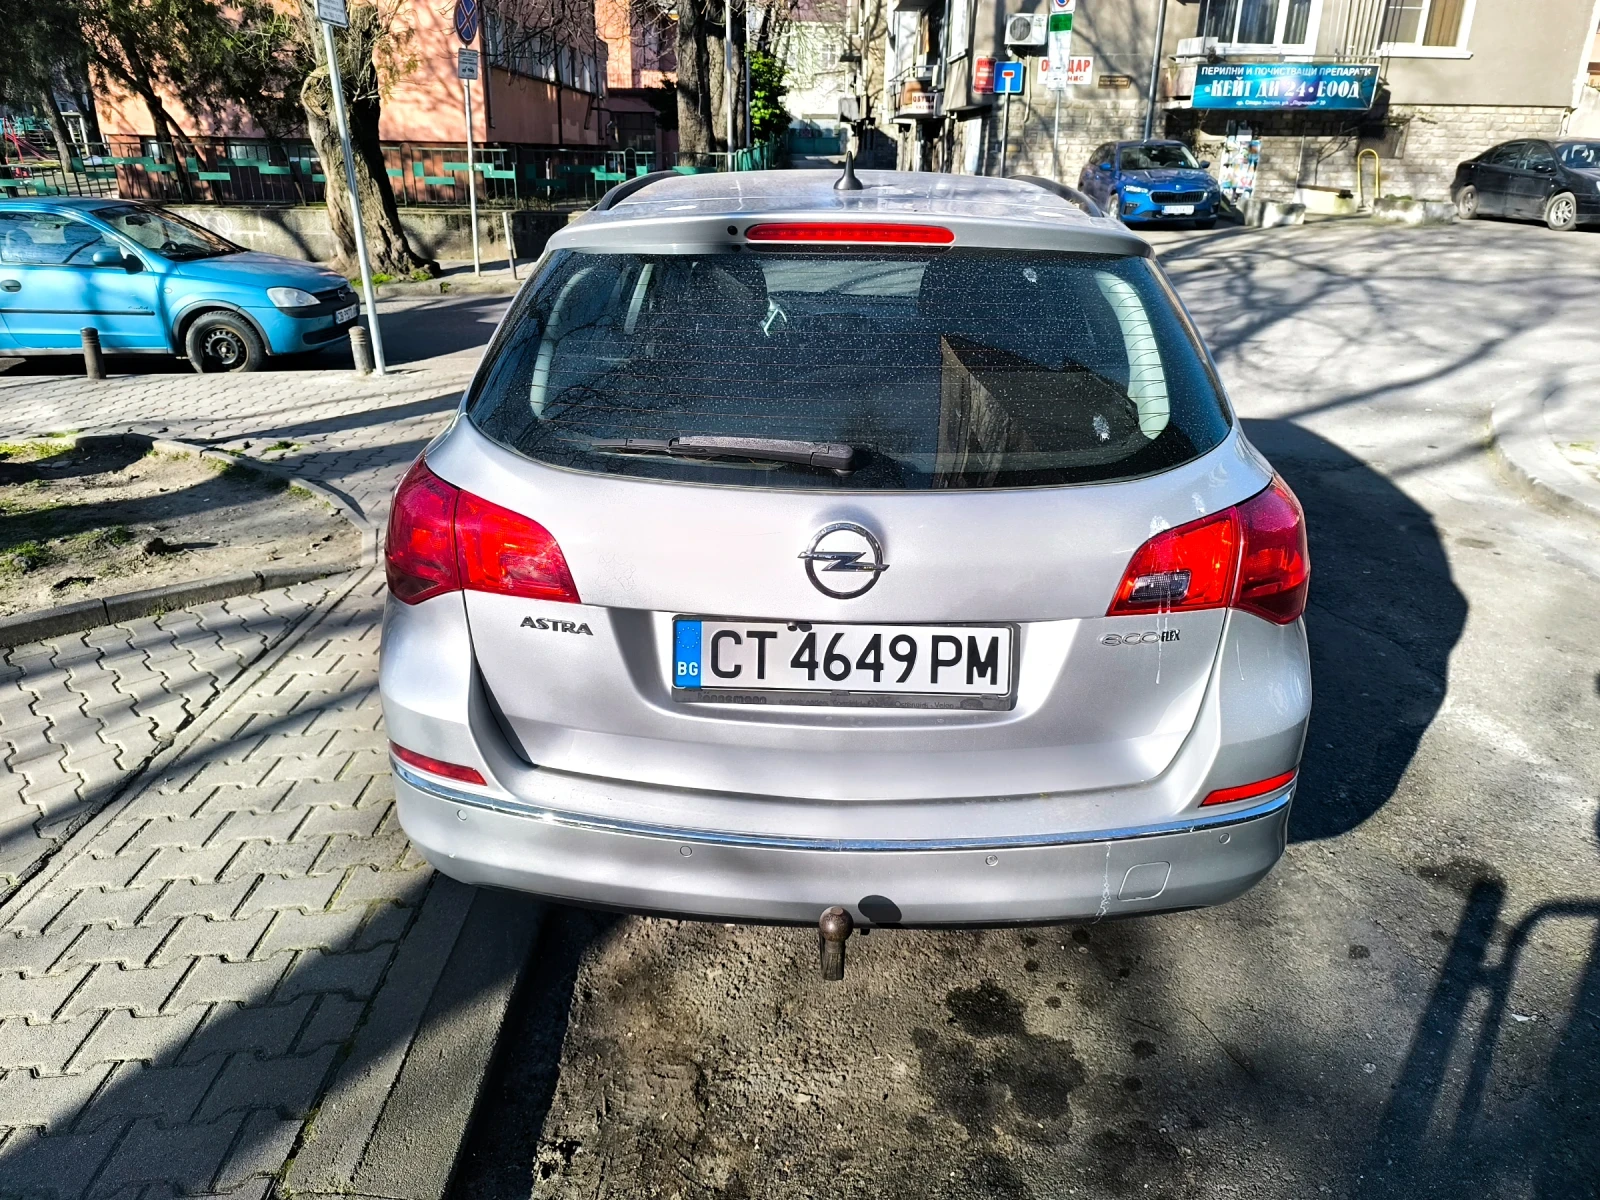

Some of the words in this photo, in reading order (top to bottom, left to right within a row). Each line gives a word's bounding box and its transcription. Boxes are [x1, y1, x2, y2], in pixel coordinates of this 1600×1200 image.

[1201, 66, 1244, 76] ПЕРИЛНИ
[1245, 67, 1253, 76] И
[1254, 67, 1317, 77] ПОЧИСТВАЩИ
[1283, 80, 1307, 97] 24
[1316, 80, 1360, 99] ЕООД
[520, 616, 593, 636] ASTRA
[710, 630, 777, 680] CT
[790, 632, 918, 684] 4649
[930, 635, 999, 685] PM
[677, 661, 699, 676] BG
